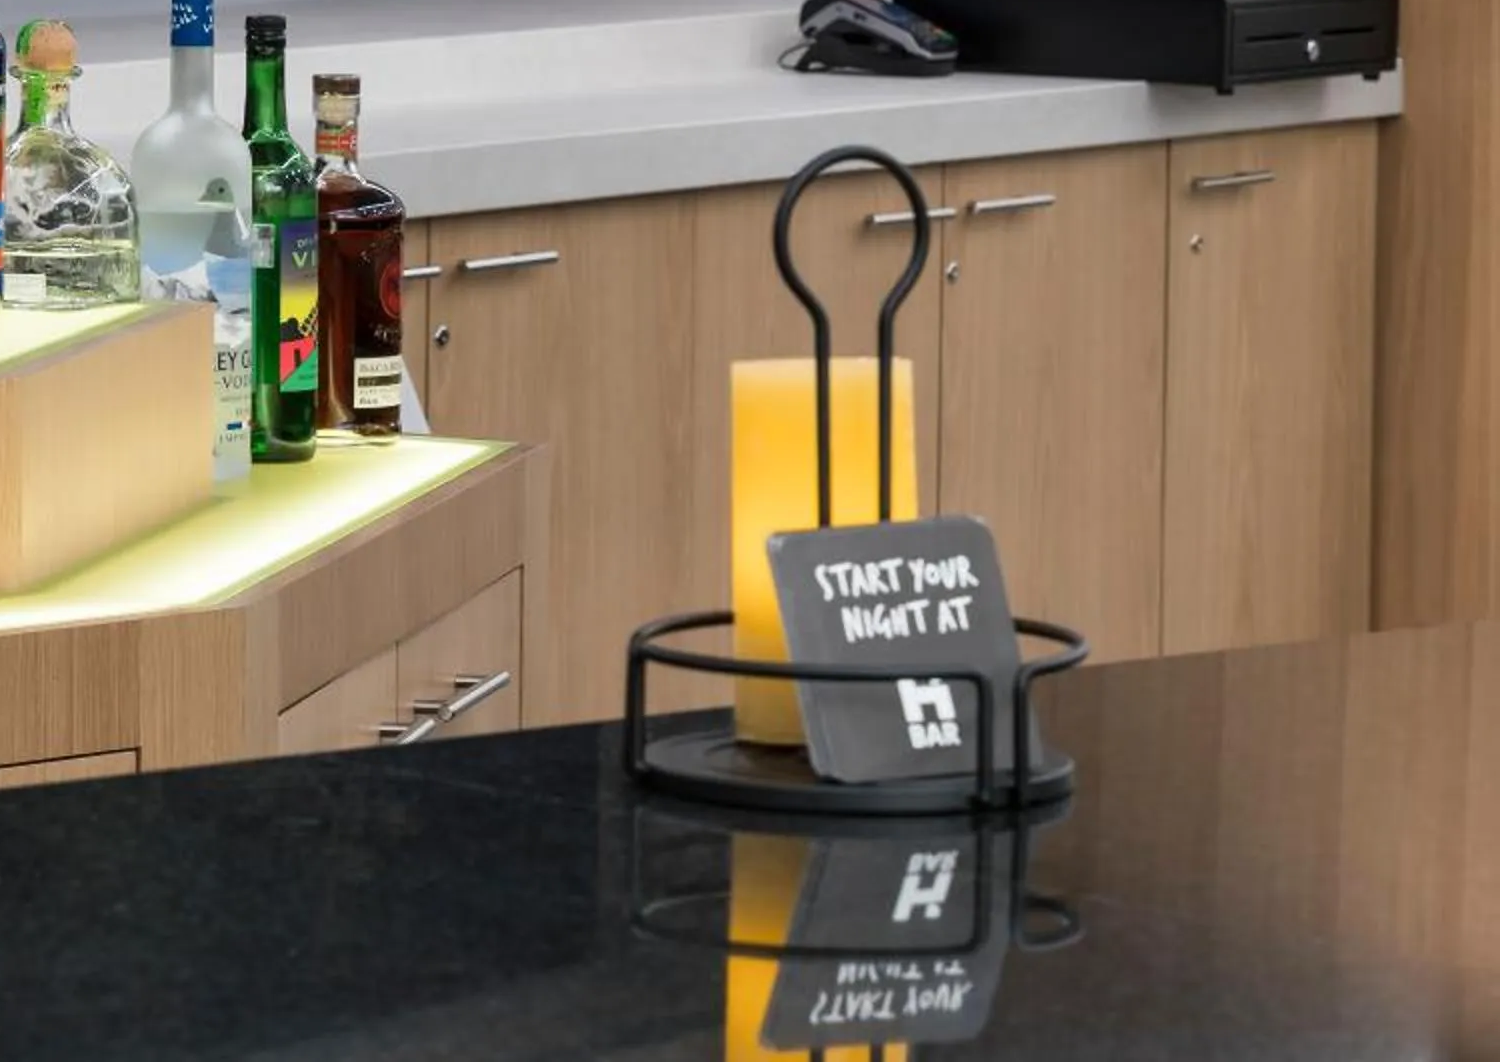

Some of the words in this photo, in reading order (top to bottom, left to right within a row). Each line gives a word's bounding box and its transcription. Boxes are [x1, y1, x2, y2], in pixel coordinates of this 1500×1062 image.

[213, 351, 238, 372] EY
[815, 558, 904, 602] START
[907, 554, 980, 594] YOUR
[841, 598, 930, 643] NIGHT
[938, 595, 973, 634] AT
[908, 721, 963, 749] BAR
